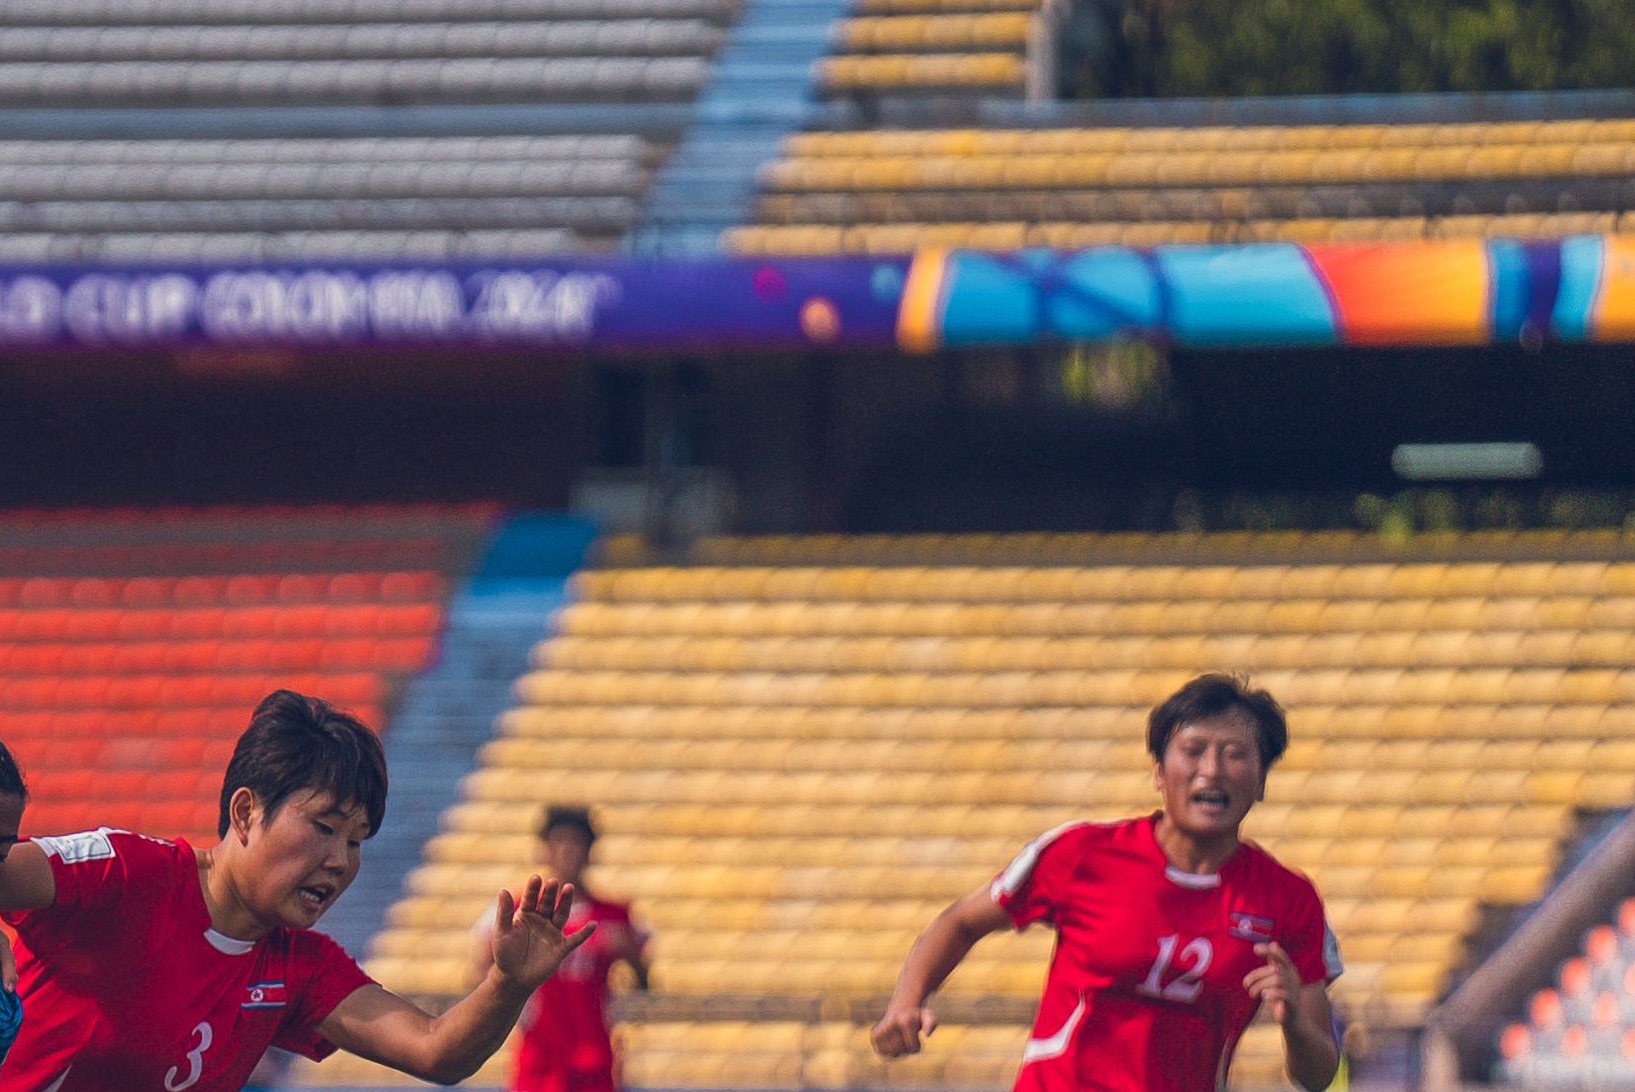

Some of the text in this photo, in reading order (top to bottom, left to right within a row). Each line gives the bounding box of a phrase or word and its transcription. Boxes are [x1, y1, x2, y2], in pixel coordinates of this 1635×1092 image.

[67, 273, 196, 334] CUP
[1135, 933, 1213, 1001] 12
[164, 1022, 213, 1092] 3
